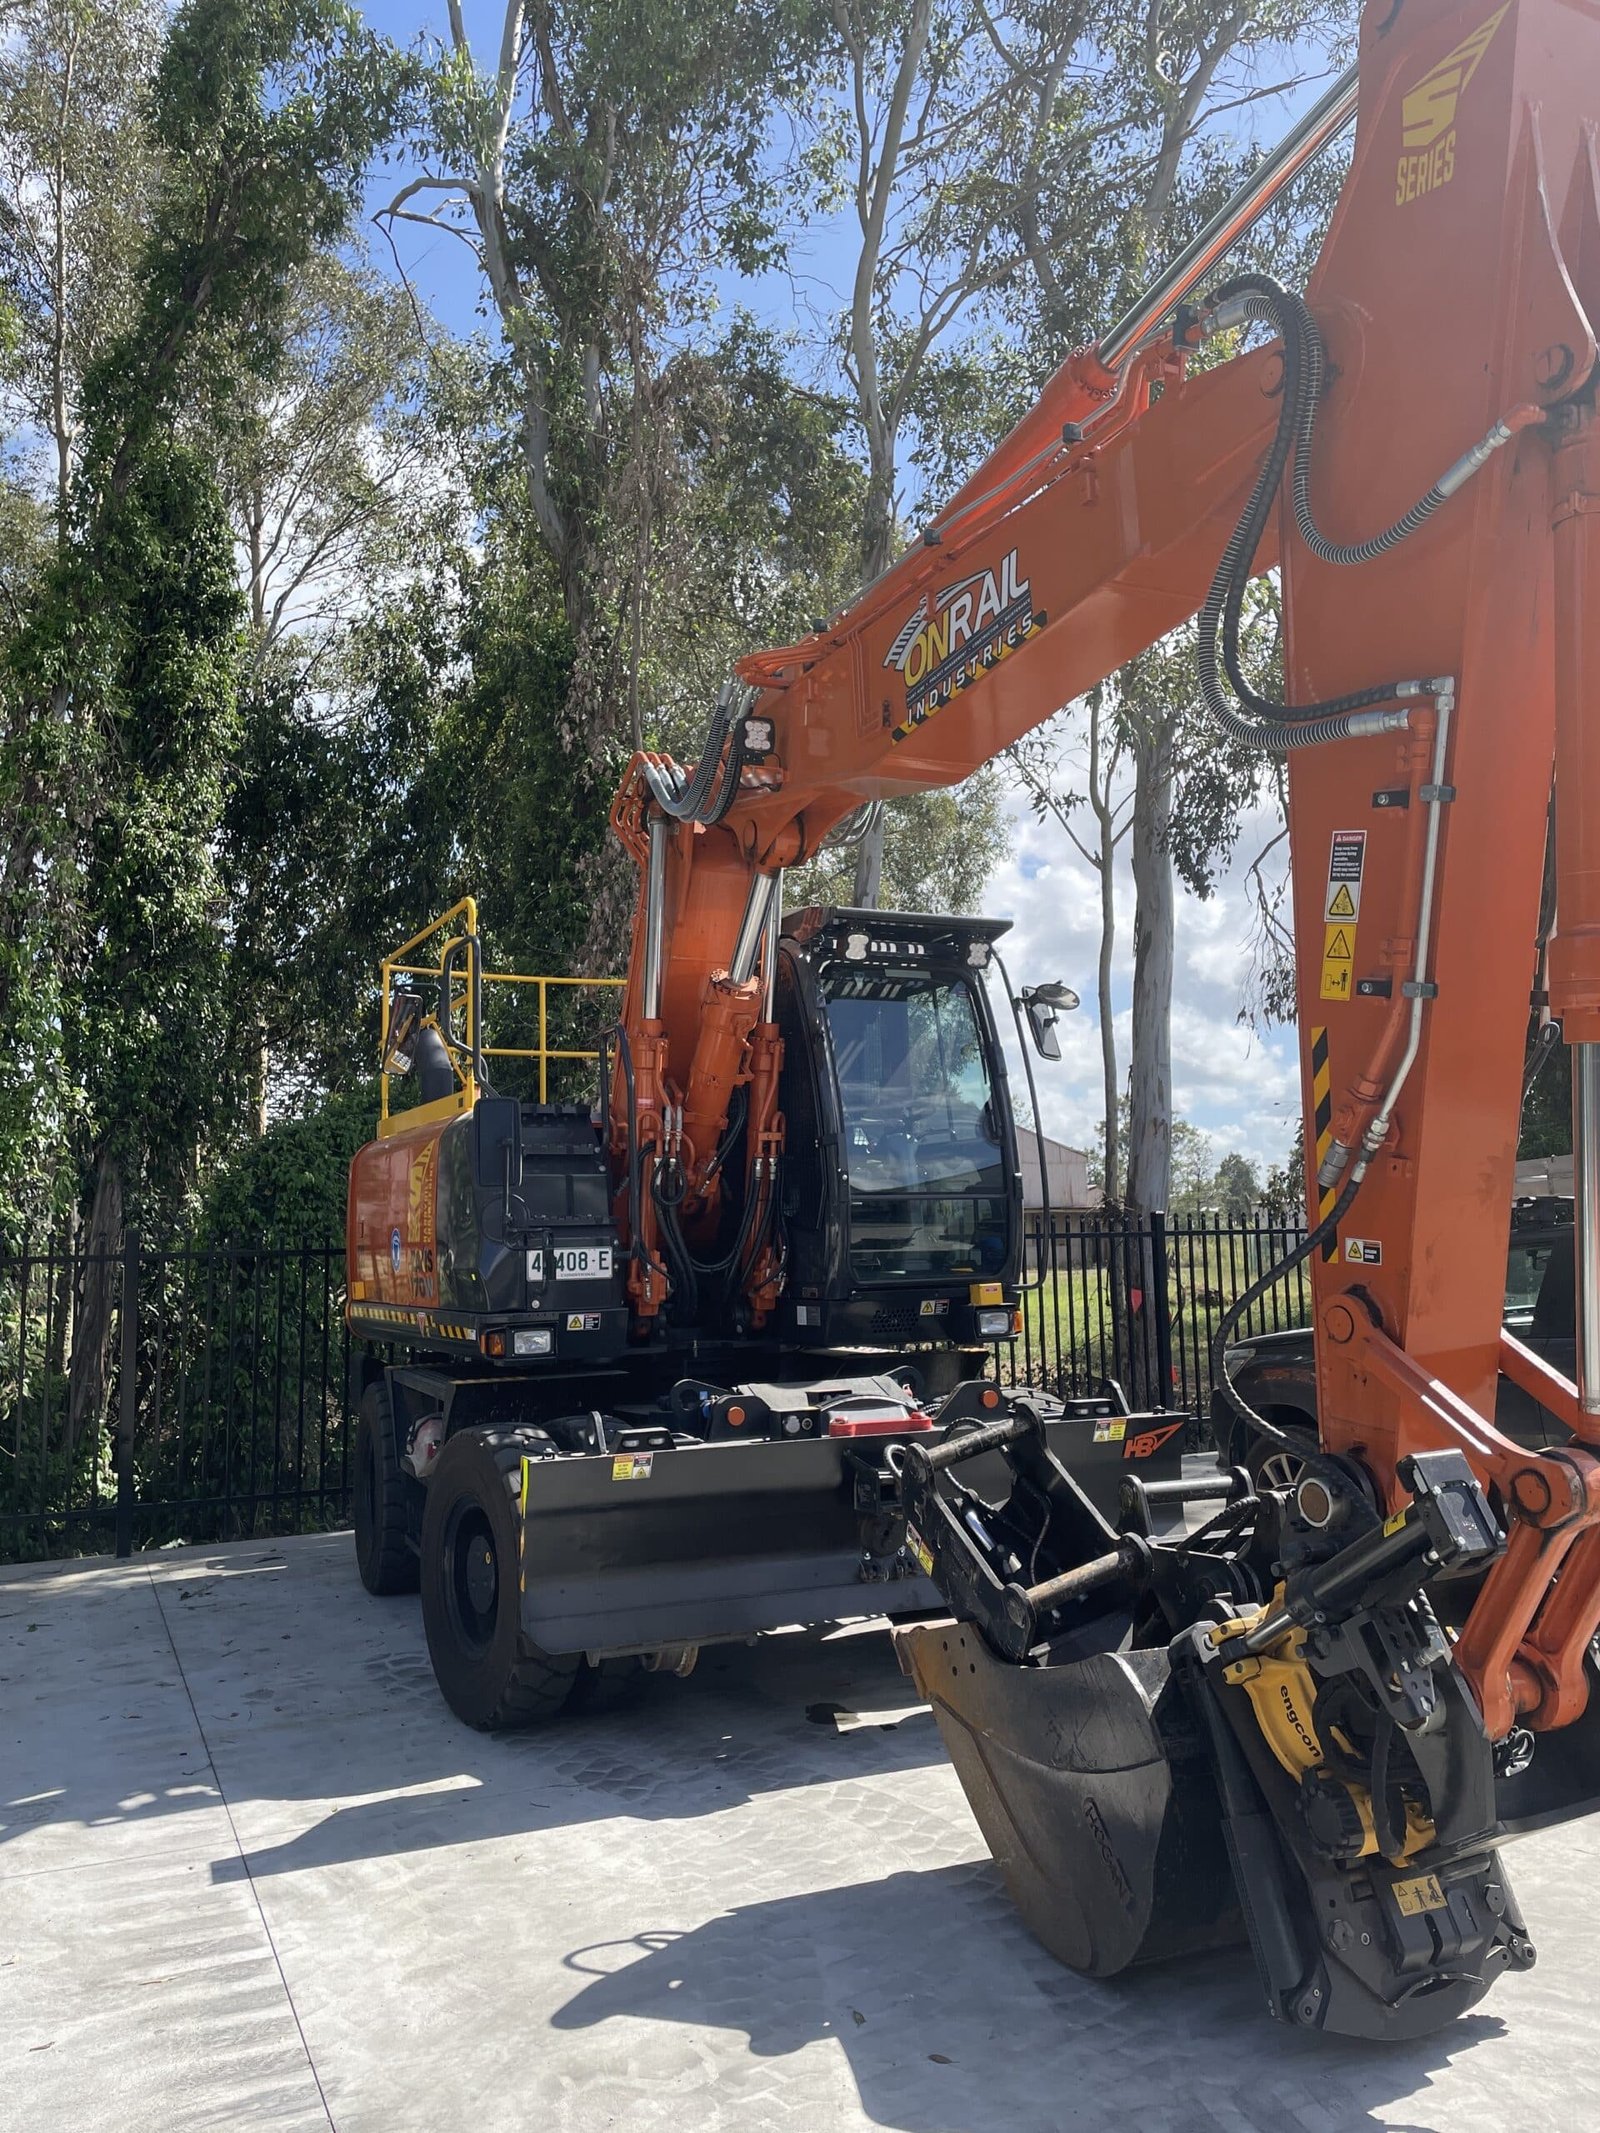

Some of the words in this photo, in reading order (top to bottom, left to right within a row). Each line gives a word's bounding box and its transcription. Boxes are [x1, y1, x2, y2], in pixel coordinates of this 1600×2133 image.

[1395, 129, 1456, 207] SERIES
[903, 546, 1031, 688] ONRAIL
[907, 610, 1032, 726] INDUSTRIES
[1280, 1684, 1321, 1758] engcon
